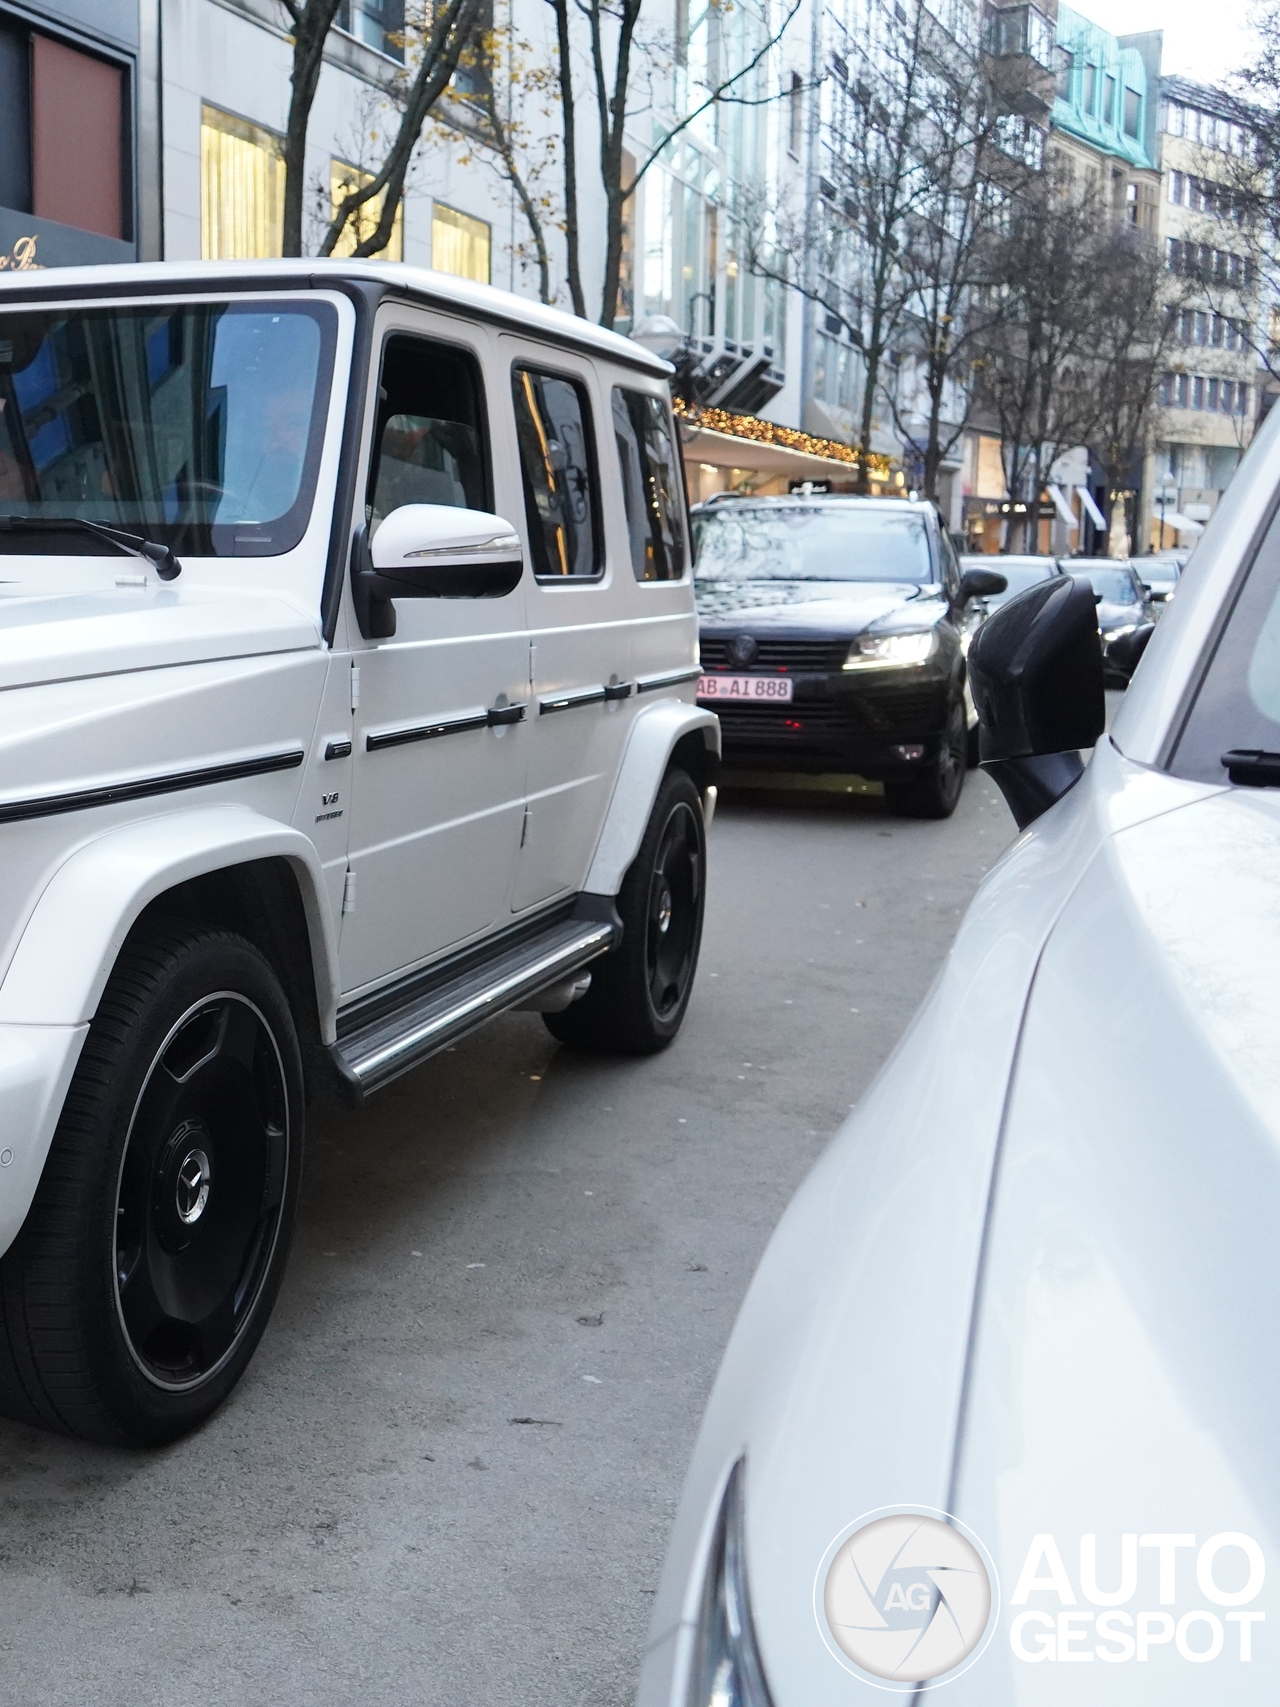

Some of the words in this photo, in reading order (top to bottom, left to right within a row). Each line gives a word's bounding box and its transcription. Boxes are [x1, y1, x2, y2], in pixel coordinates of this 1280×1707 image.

[697, 679, 717, 695] AB
[755, 682, 788, 697] 888
[322, 792, 339, 805] V8
